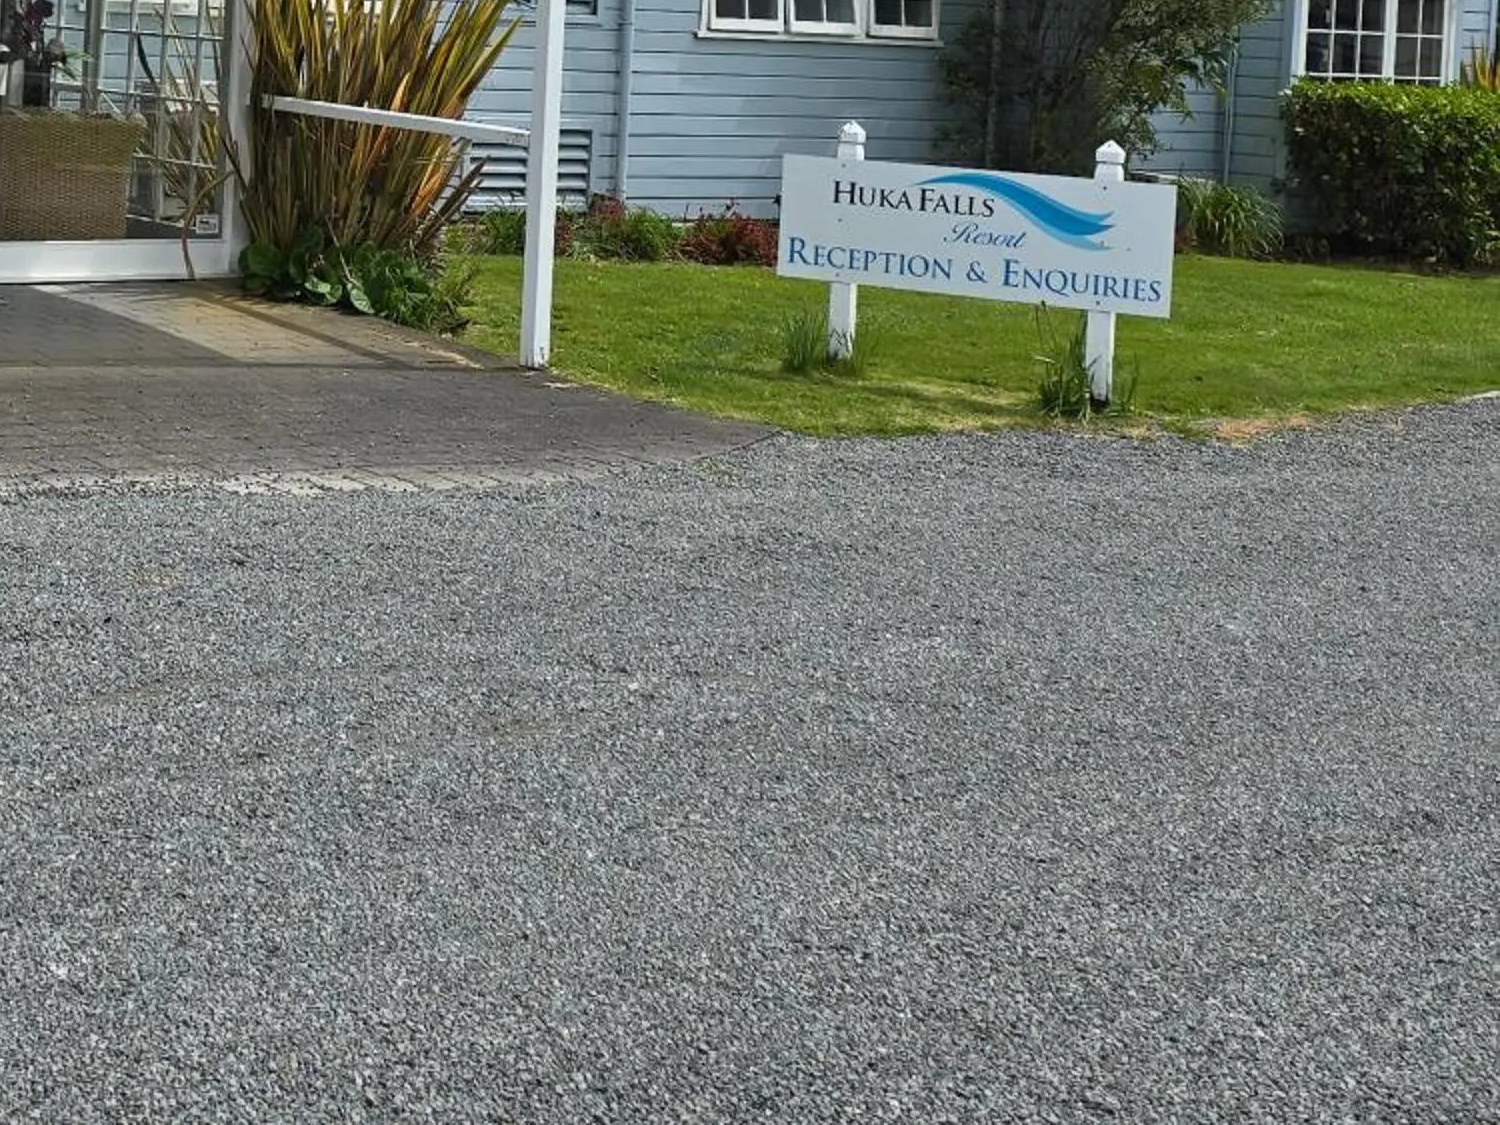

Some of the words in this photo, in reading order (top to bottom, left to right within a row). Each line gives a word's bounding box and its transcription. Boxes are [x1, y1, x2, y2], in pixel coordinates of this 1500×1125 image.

[943, 222, 1028, 249] Resort
[787, 236, 953, 280] RECEPTION
[966, 261, 988, 283] &
[1002, 259, 1162, 302] ENQUIRIES
